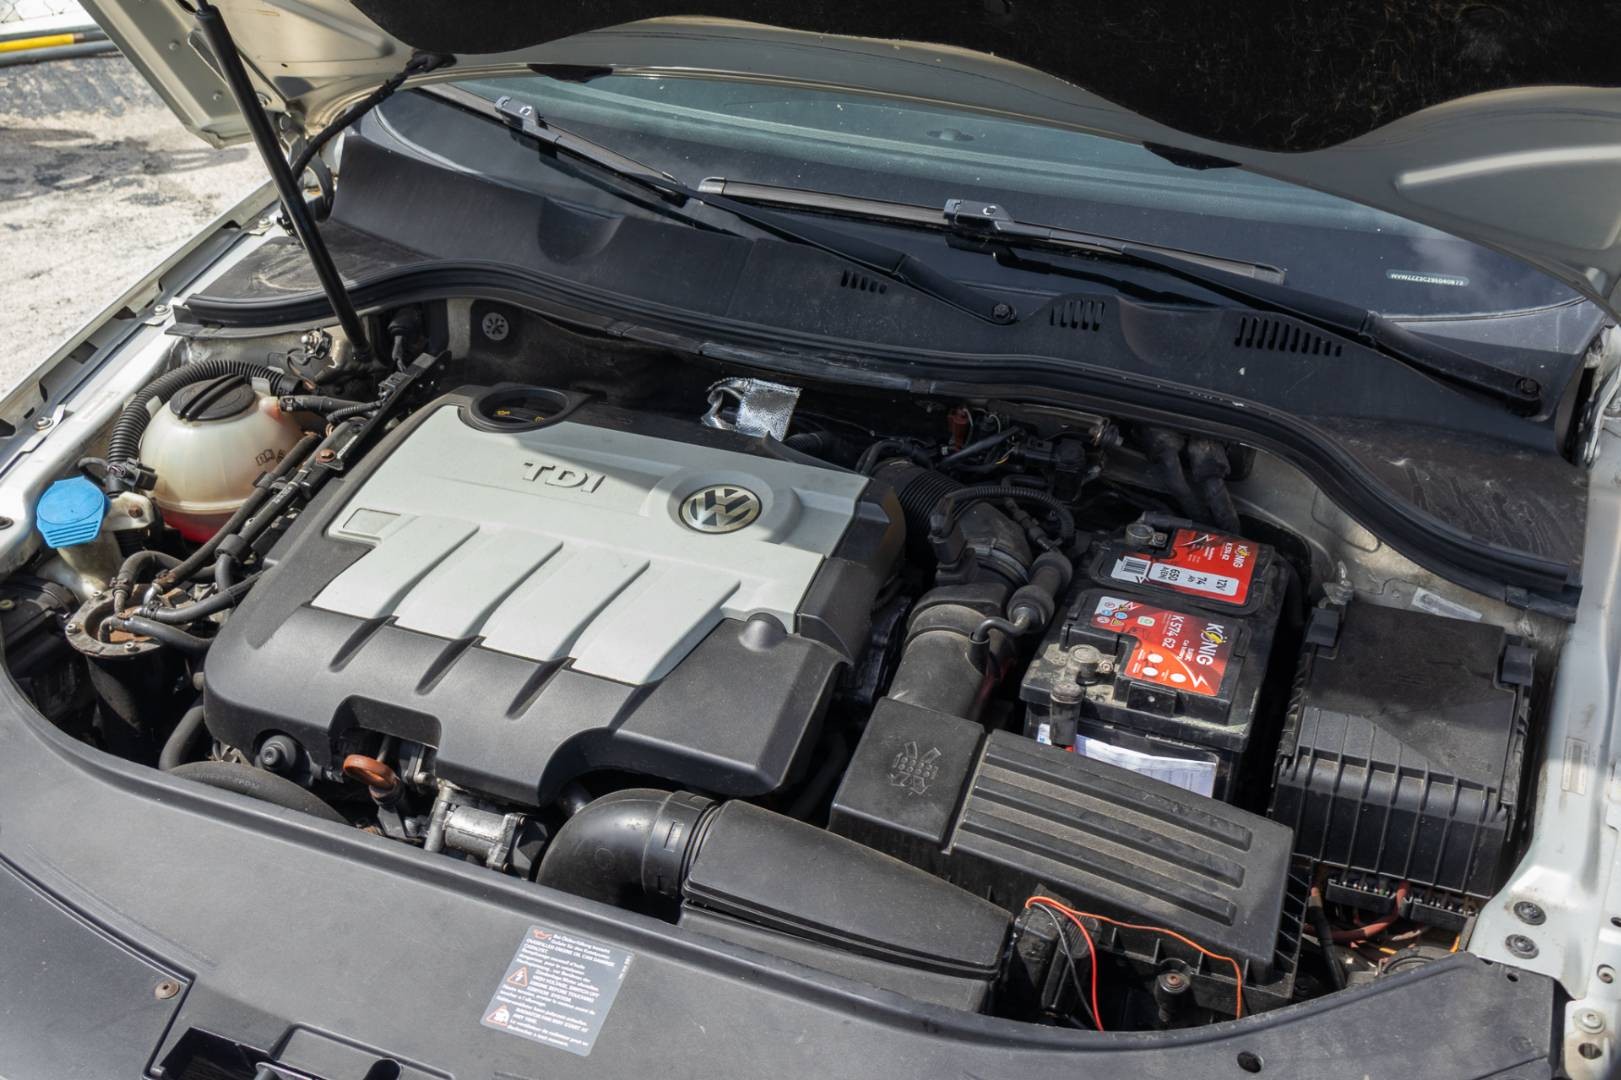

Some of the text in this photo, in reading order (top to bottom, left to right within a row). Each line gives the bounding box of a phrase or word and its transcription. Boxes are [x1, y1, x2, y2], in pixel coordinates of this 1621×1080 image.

[523, 462, 607, 494] TDI
[1168, 569, 1180, 582] 650
[1197, 577, 1207, 585] 74
[1216, 579, 1228, 591] 12V
[1166, 620, 1181, 637] 574
[1162, 637, 1176, 648] 62
[1196, 623, 1228, 666] KÖNIG
